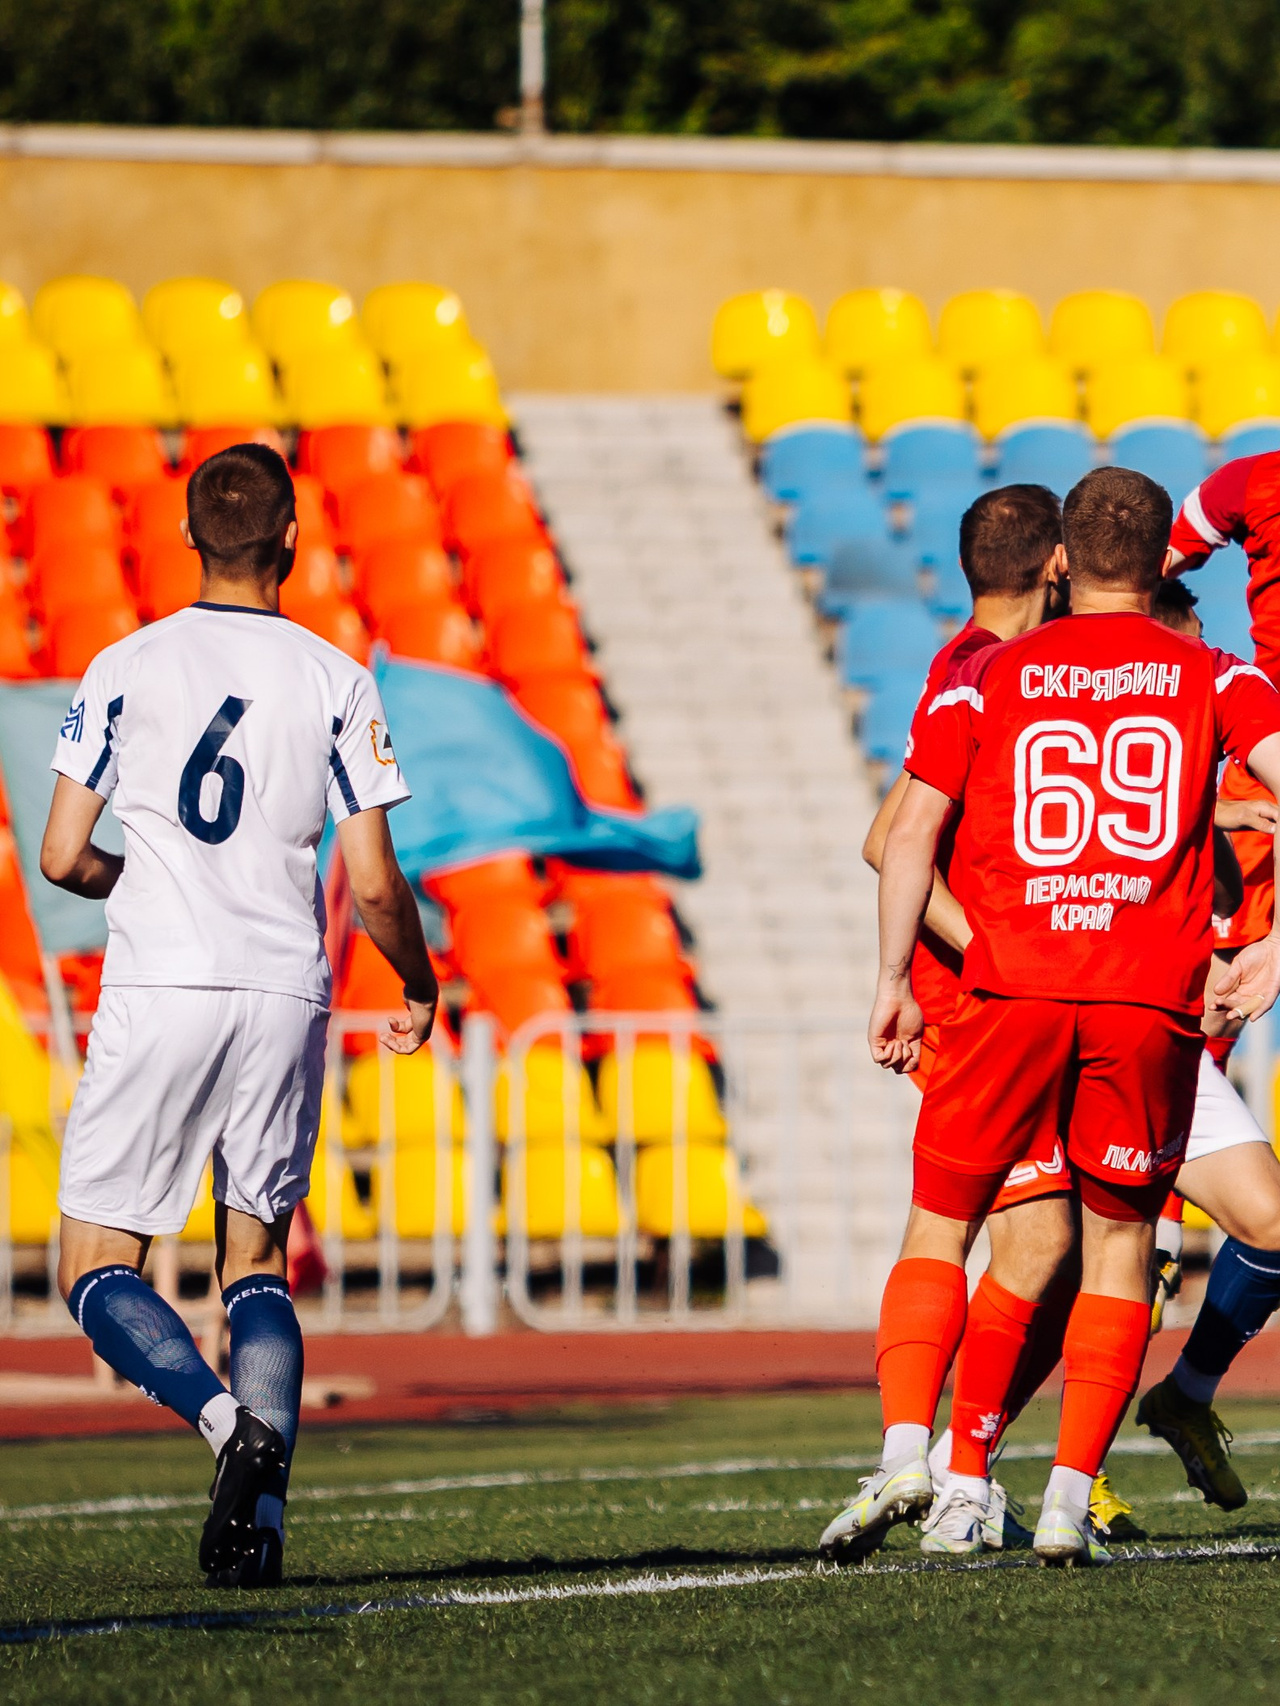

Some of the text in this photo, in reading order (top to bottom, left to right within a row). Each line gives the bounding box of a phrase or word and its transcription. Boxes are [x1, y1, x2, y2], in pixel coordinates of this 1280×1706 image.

[1020, 662, 1181, 700] СКРЯБИН
[178, 695, 254, 845] 6
[1013, 716, 1183, 867] 69
[1025, 873, 1151, 905] ПЕРМСКИЙ
[1051, 904, 1115, 931] КРАЙ
[232, 1286, 286, 1305] KELME
